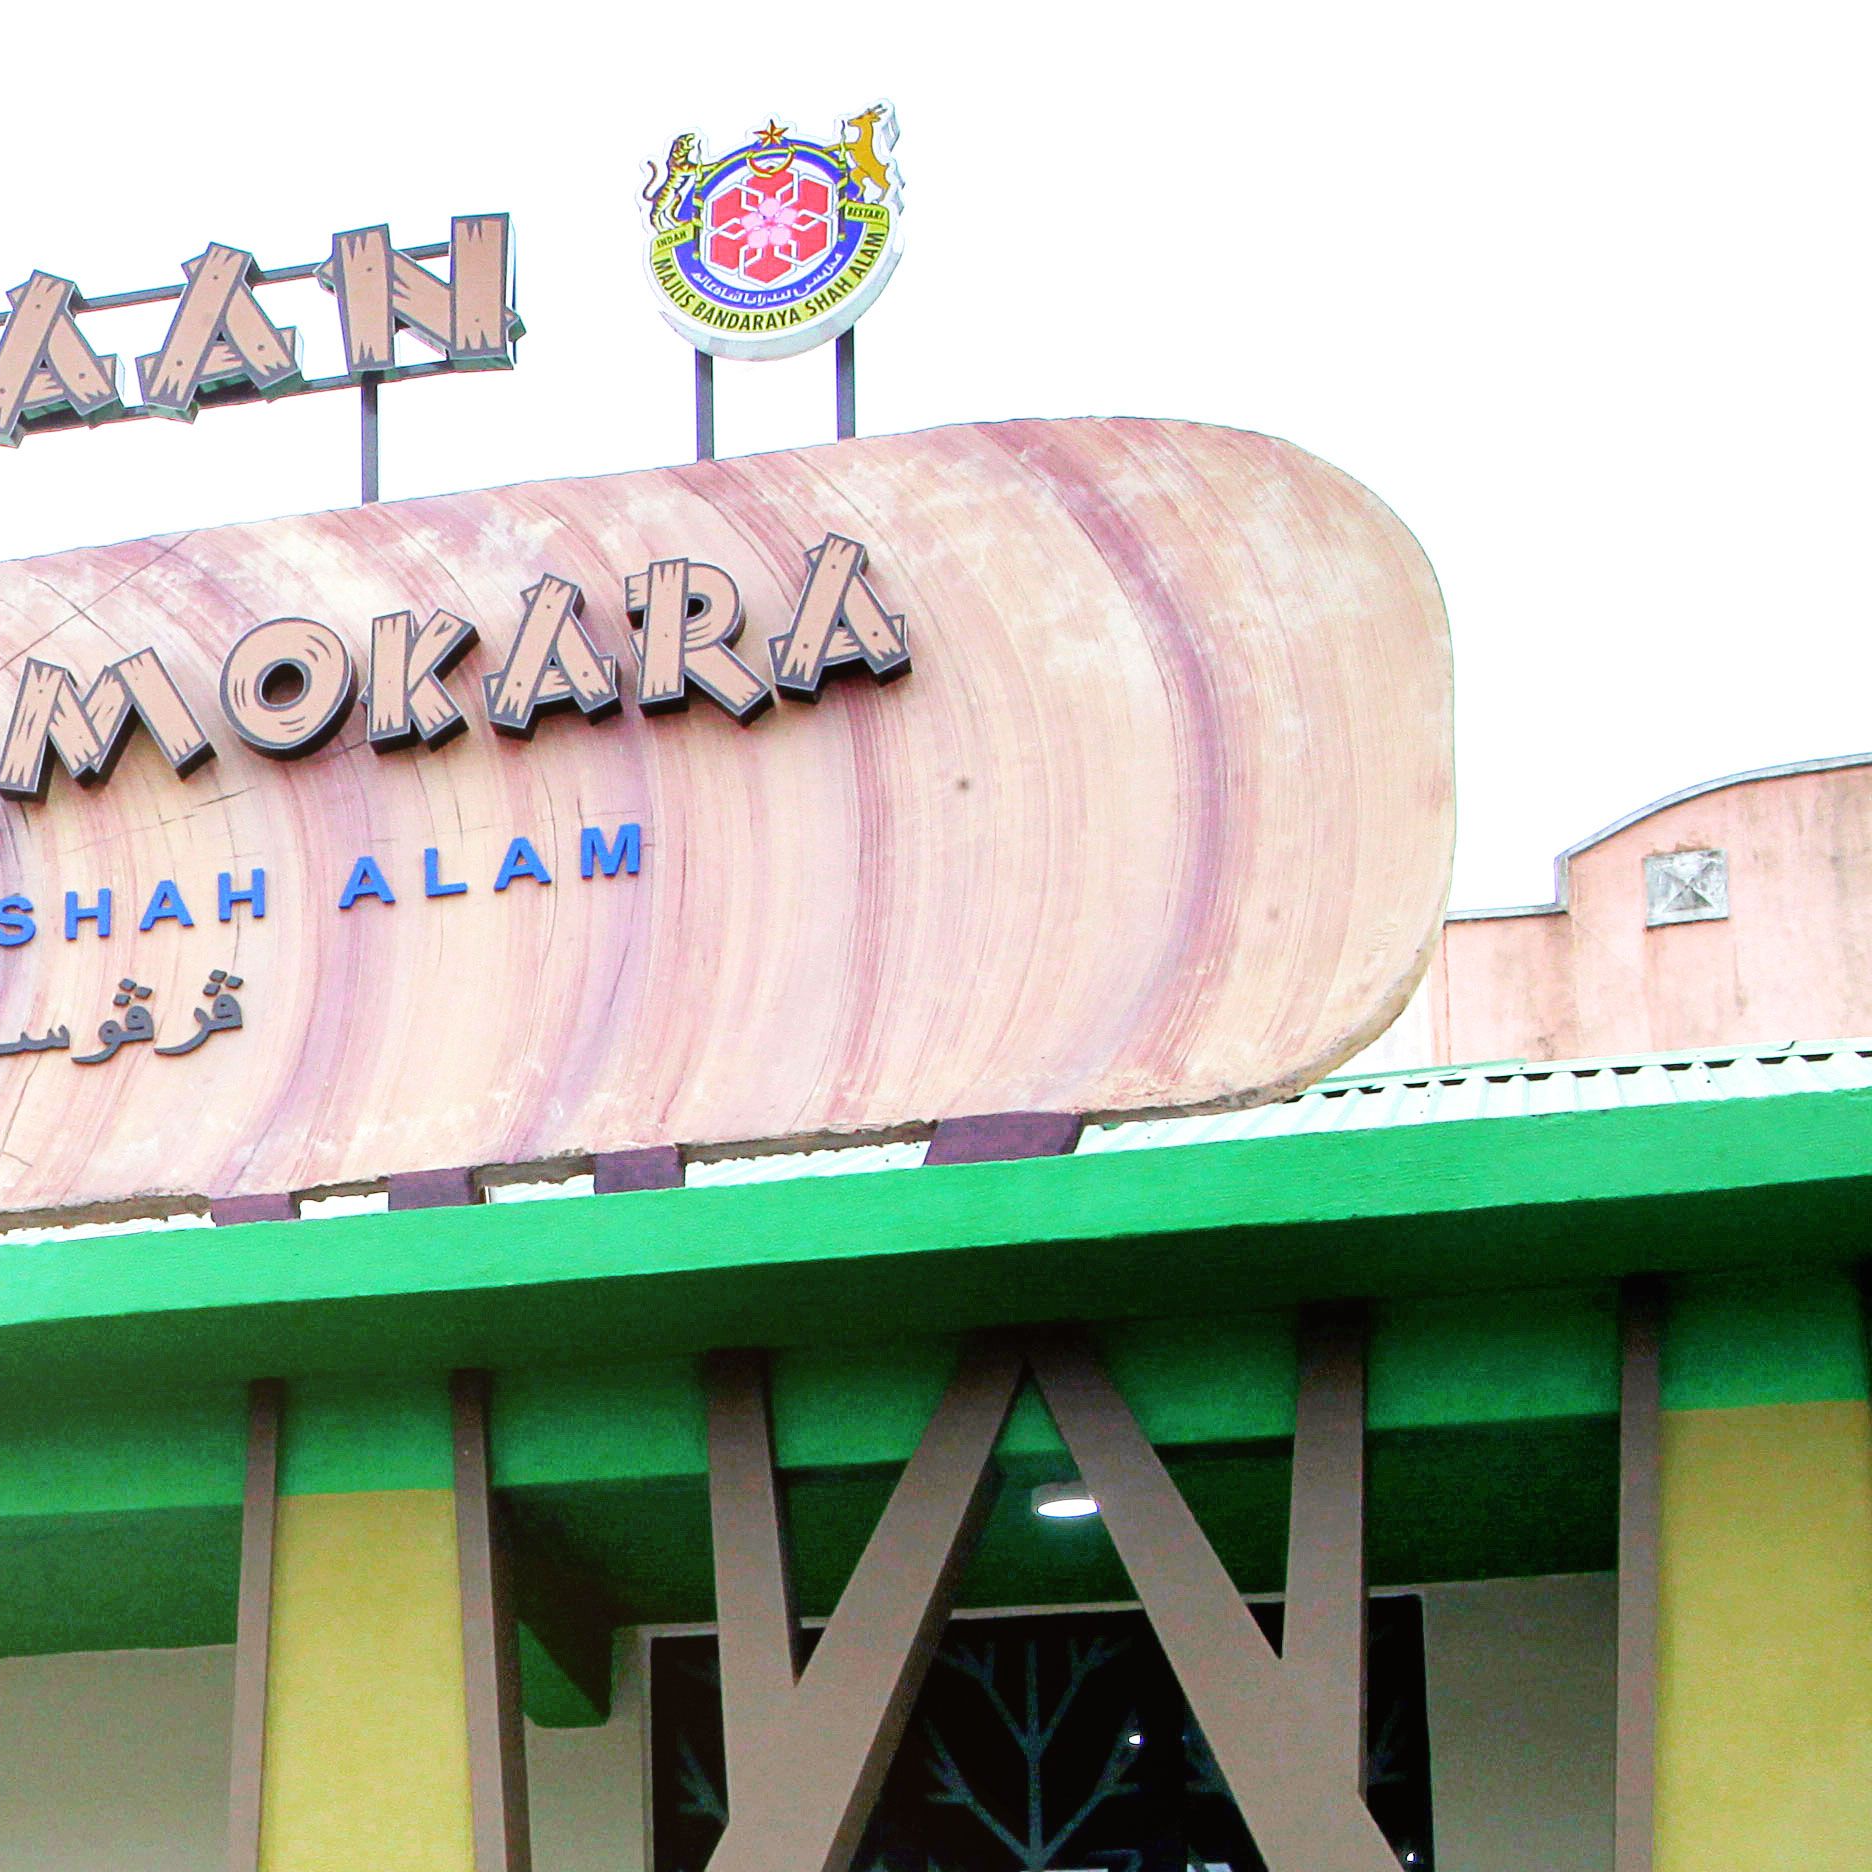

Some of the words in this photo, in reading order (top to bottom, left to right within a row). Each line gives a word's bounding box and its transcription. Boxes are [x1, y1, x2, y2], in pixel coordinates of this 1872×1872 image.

[655, 230, 688, 249] INDAH
[846, 206, 886, 220] BESTARI
[653, 257, 695, 308] MAJLIS
[692, 300, 801, 331] BANDARAYA
[805, 279, 854, 317] SHAH
[849, 231, 885, 280] ALAM
[337, 822, 643, 910] ALAM
